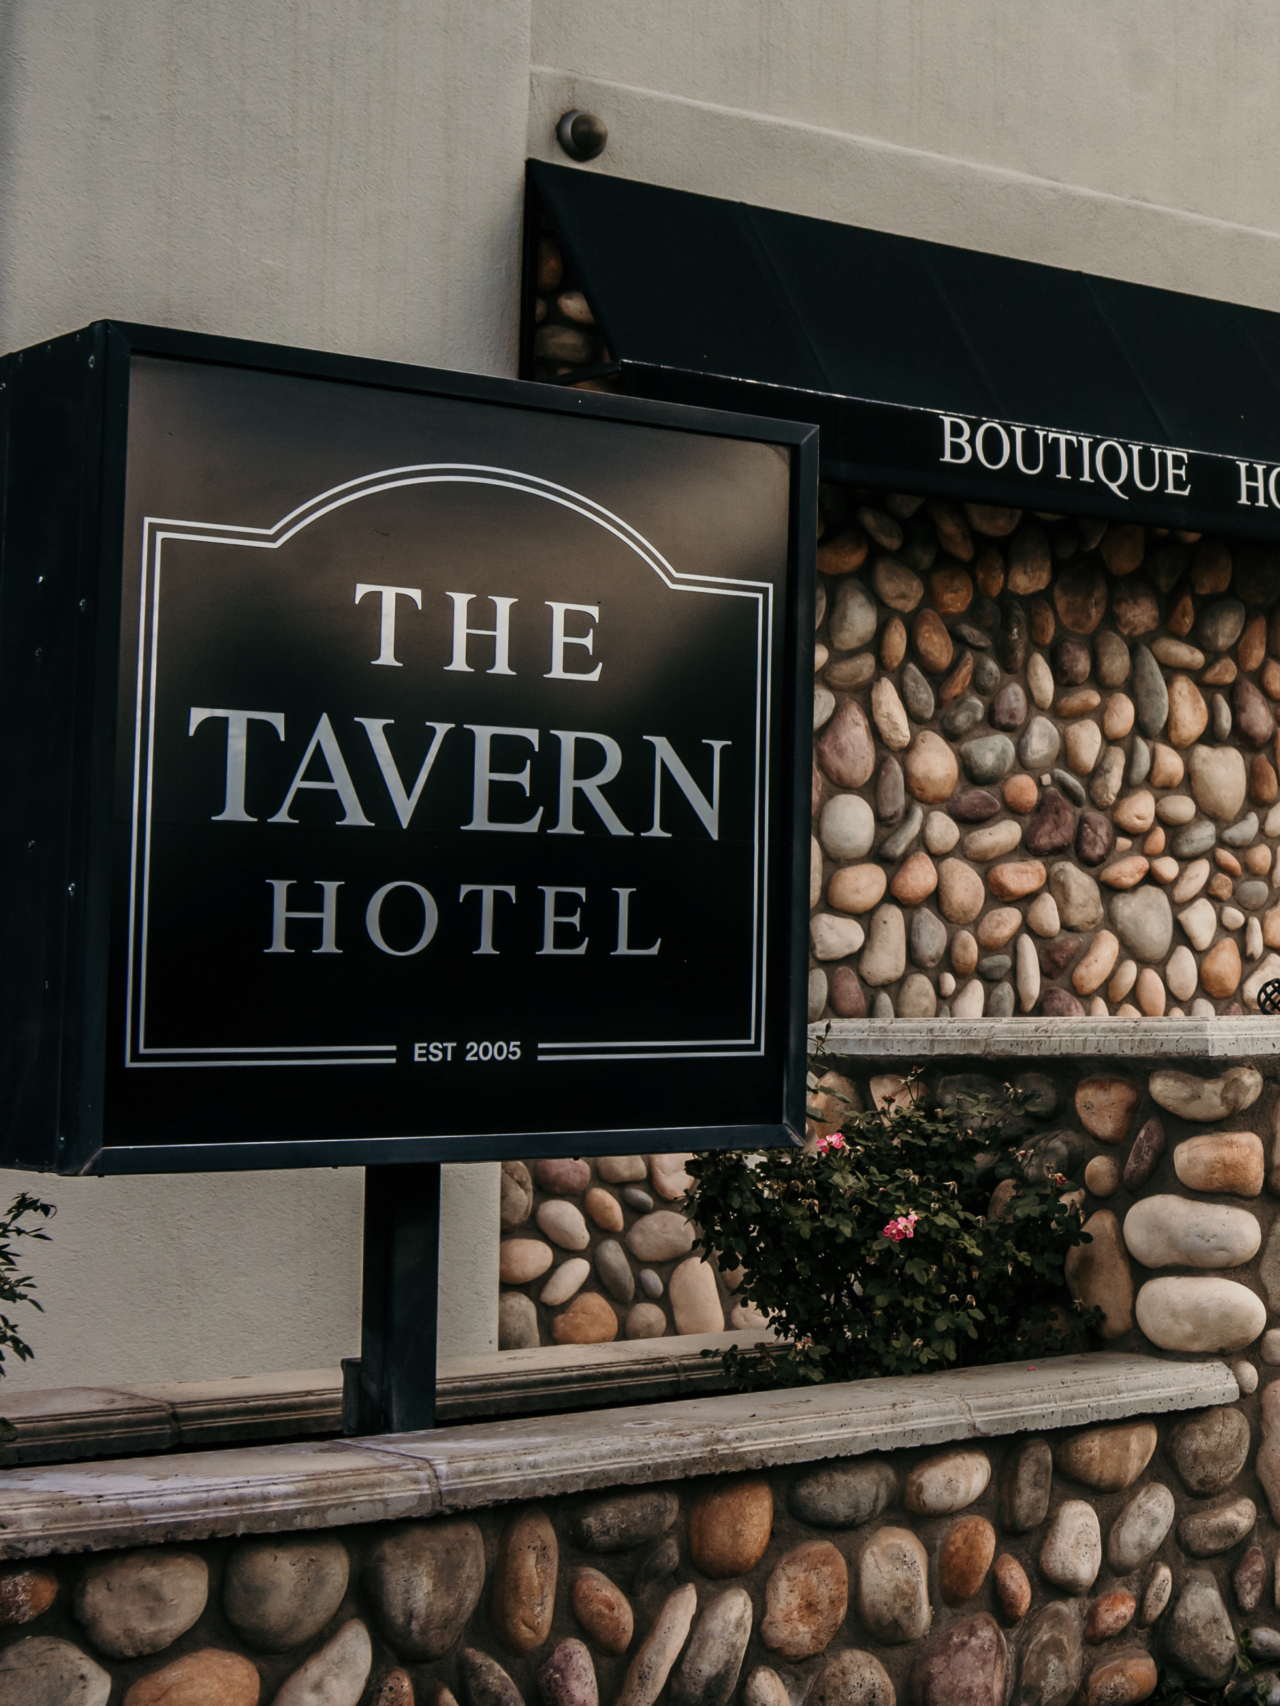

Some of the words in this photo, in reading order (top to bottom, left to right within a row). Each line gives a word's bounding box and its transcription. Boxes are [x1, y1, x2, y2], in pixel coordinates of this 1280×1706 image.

[939, 415, 1192, 500] BOUTIQUE
[354, 582, 604, 683] THE
[188, 706, 733, 841] TAVERN
[263, 879, 662, 957] HOTEL
[413, 1042, 457, 1061] EST
[465, 1041, 521, 1061] 2005
